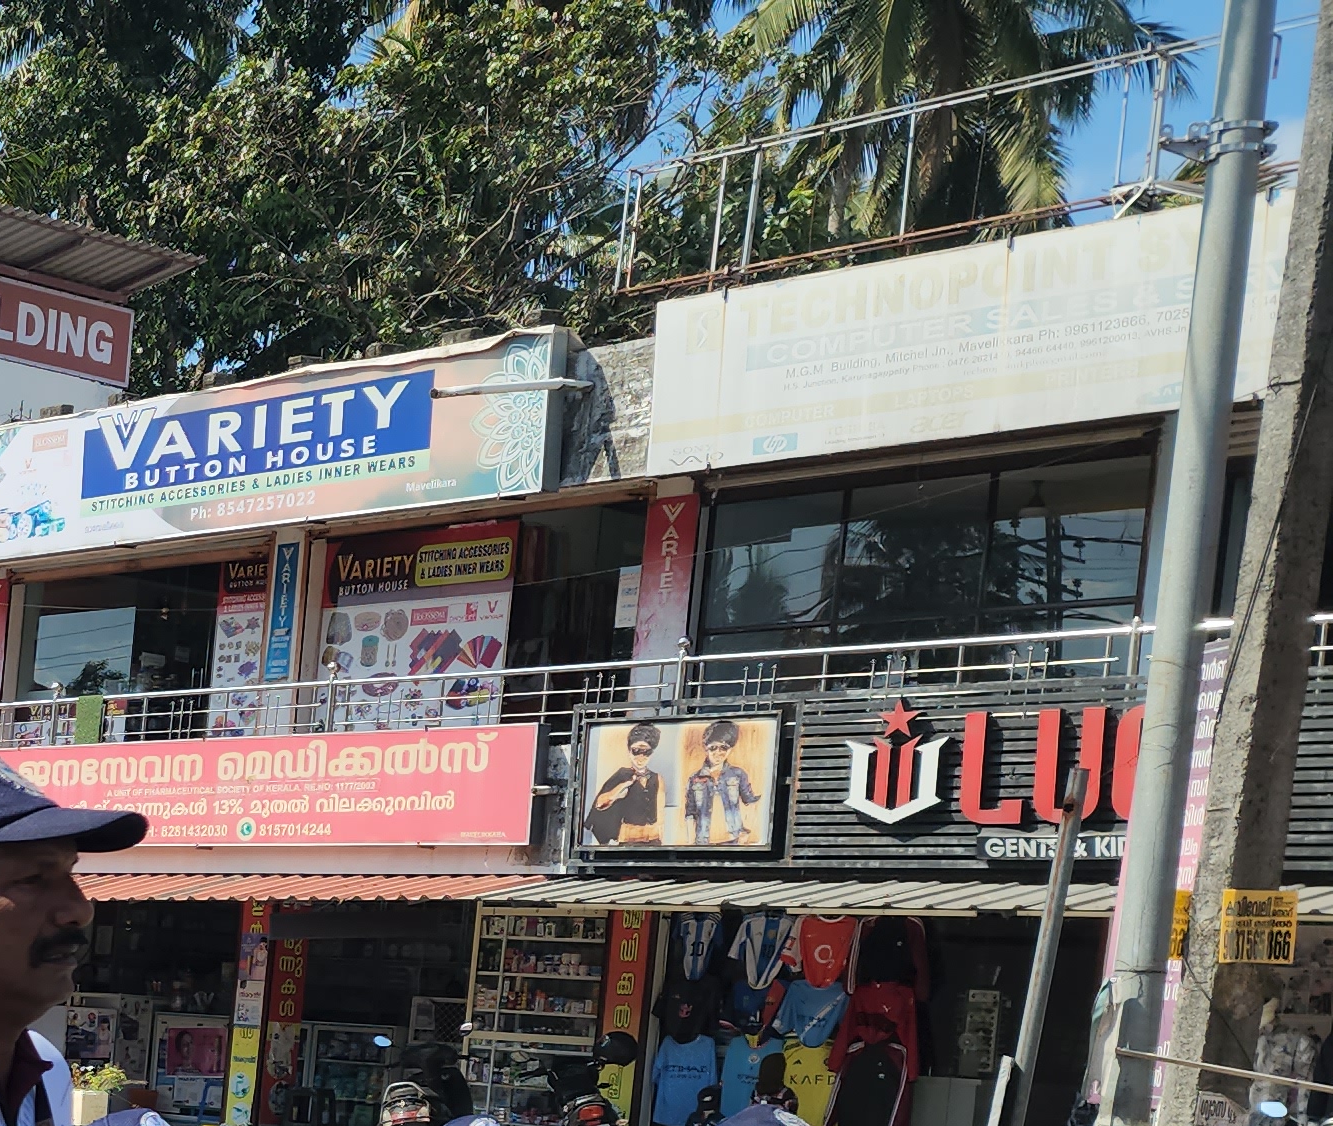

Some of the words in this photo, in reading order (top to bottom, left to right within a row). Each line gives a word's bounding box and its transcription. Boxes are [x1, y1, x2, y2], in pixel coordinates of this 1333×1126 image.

[766, 315, 973, 364] COMPUTER
[785, 365, 824, 379] M.G.M
[98, 379, 411, 471] VARIETY
[125, 455, 246, 490] BUTTON
[266, 435, 376, 469] HOUSE
[92, 492, 155, 512] STITCHING
[160, 480, 245, 502] ACCESSORIES
[252, 478, 260, 489] &
[266, 471, 313, 488] LADIES
[319, 463, 361, 481] INNER
[367, 455, 416, 473] WEARS
[405, 476, 457, 494] Mavelikara
[190, 506, 212, 521] Ph:
[217, 490, 316, 517] 8547257022
[418, 547, 456, 564] STITCHING
[457, 542, 510, 559] ACCESSORIES
[337, 553, 415, 582] VARIETY
[427, 565, 453, 580] LADIES
[454, 562, 477, 576] INNER
[478, 560, 504, 574] WEARS
[338, 582, 377, 597] BUTTON
[378, 579, 409, 593] HOUSE
[18, 754, 202, 787] ജനസേവന
[217, 732, 498, 782] മെഡിക്കൽസ്
[213, 799, 244, 815] 13%
[316, 790, 455, 816] വിലക്കുറവിൽ
[259, 823, 332, 837] 8157014244
[690, 940, 704, 957] 10
